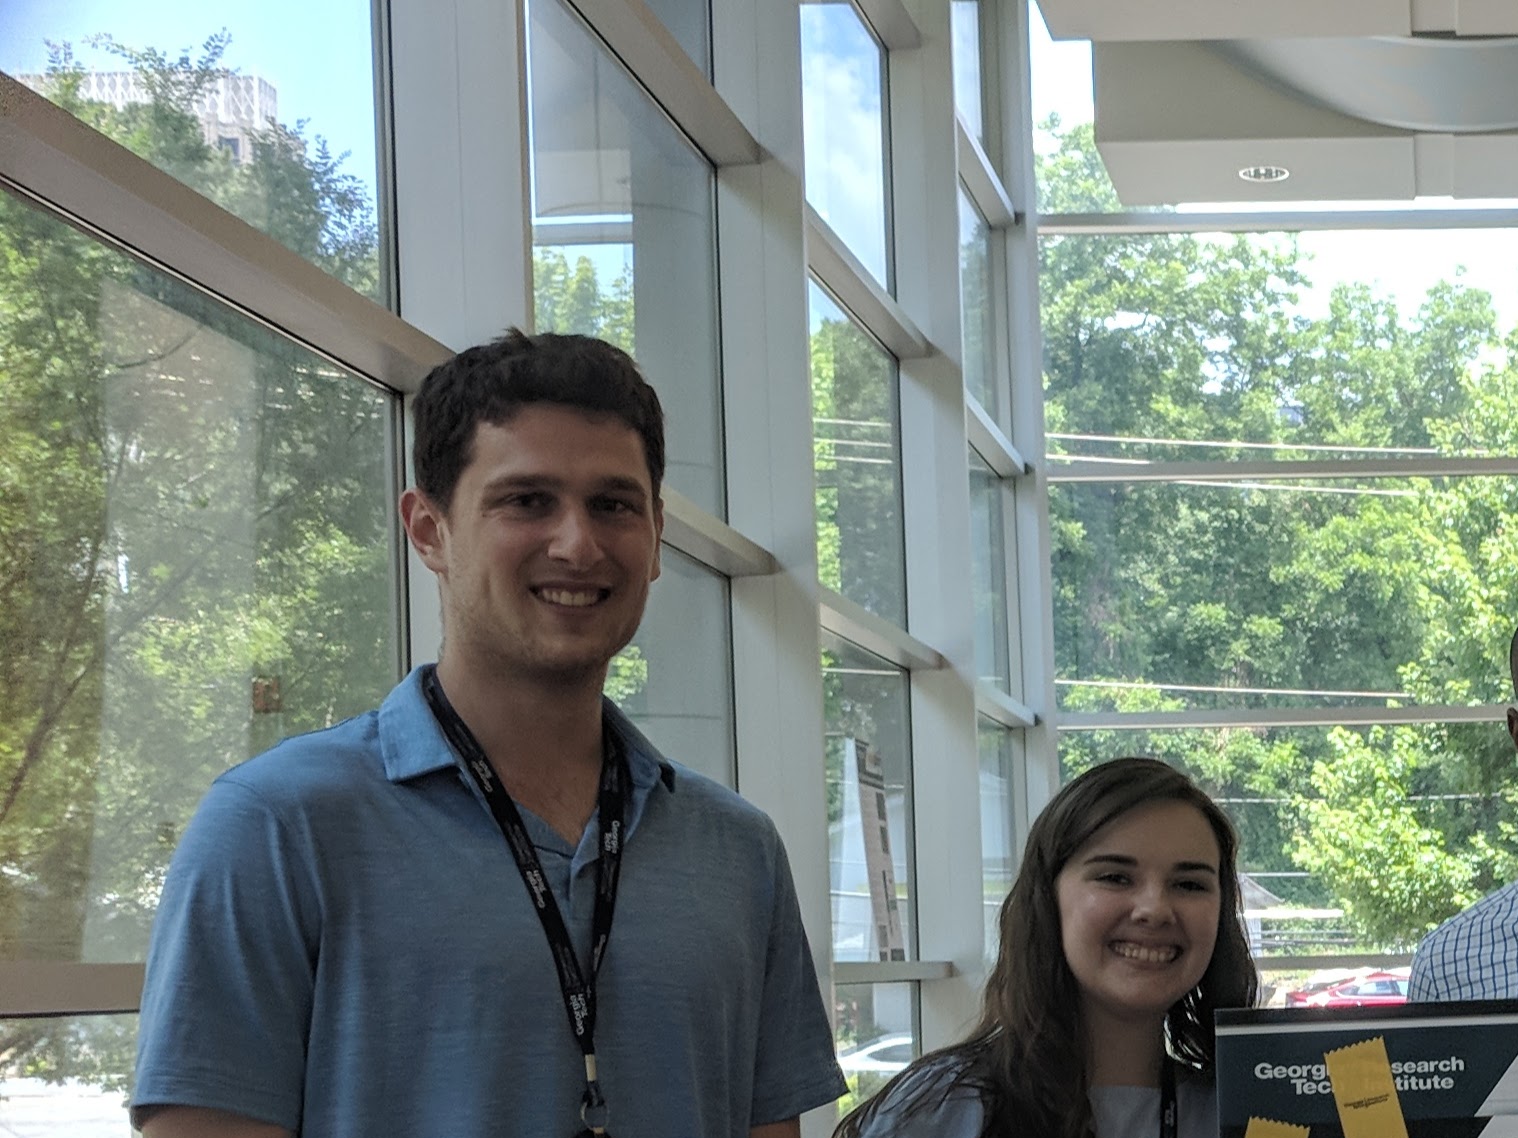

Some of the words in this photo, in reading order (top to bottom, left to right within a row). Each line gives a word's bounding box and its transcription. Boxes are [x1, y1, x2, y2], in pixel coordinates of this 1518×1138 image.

[1254, 1063, 1329, 1080] Georgi
[1391, 1057, 1464, 1074] search
[1291, 1078, 1334, 1095] Tec
